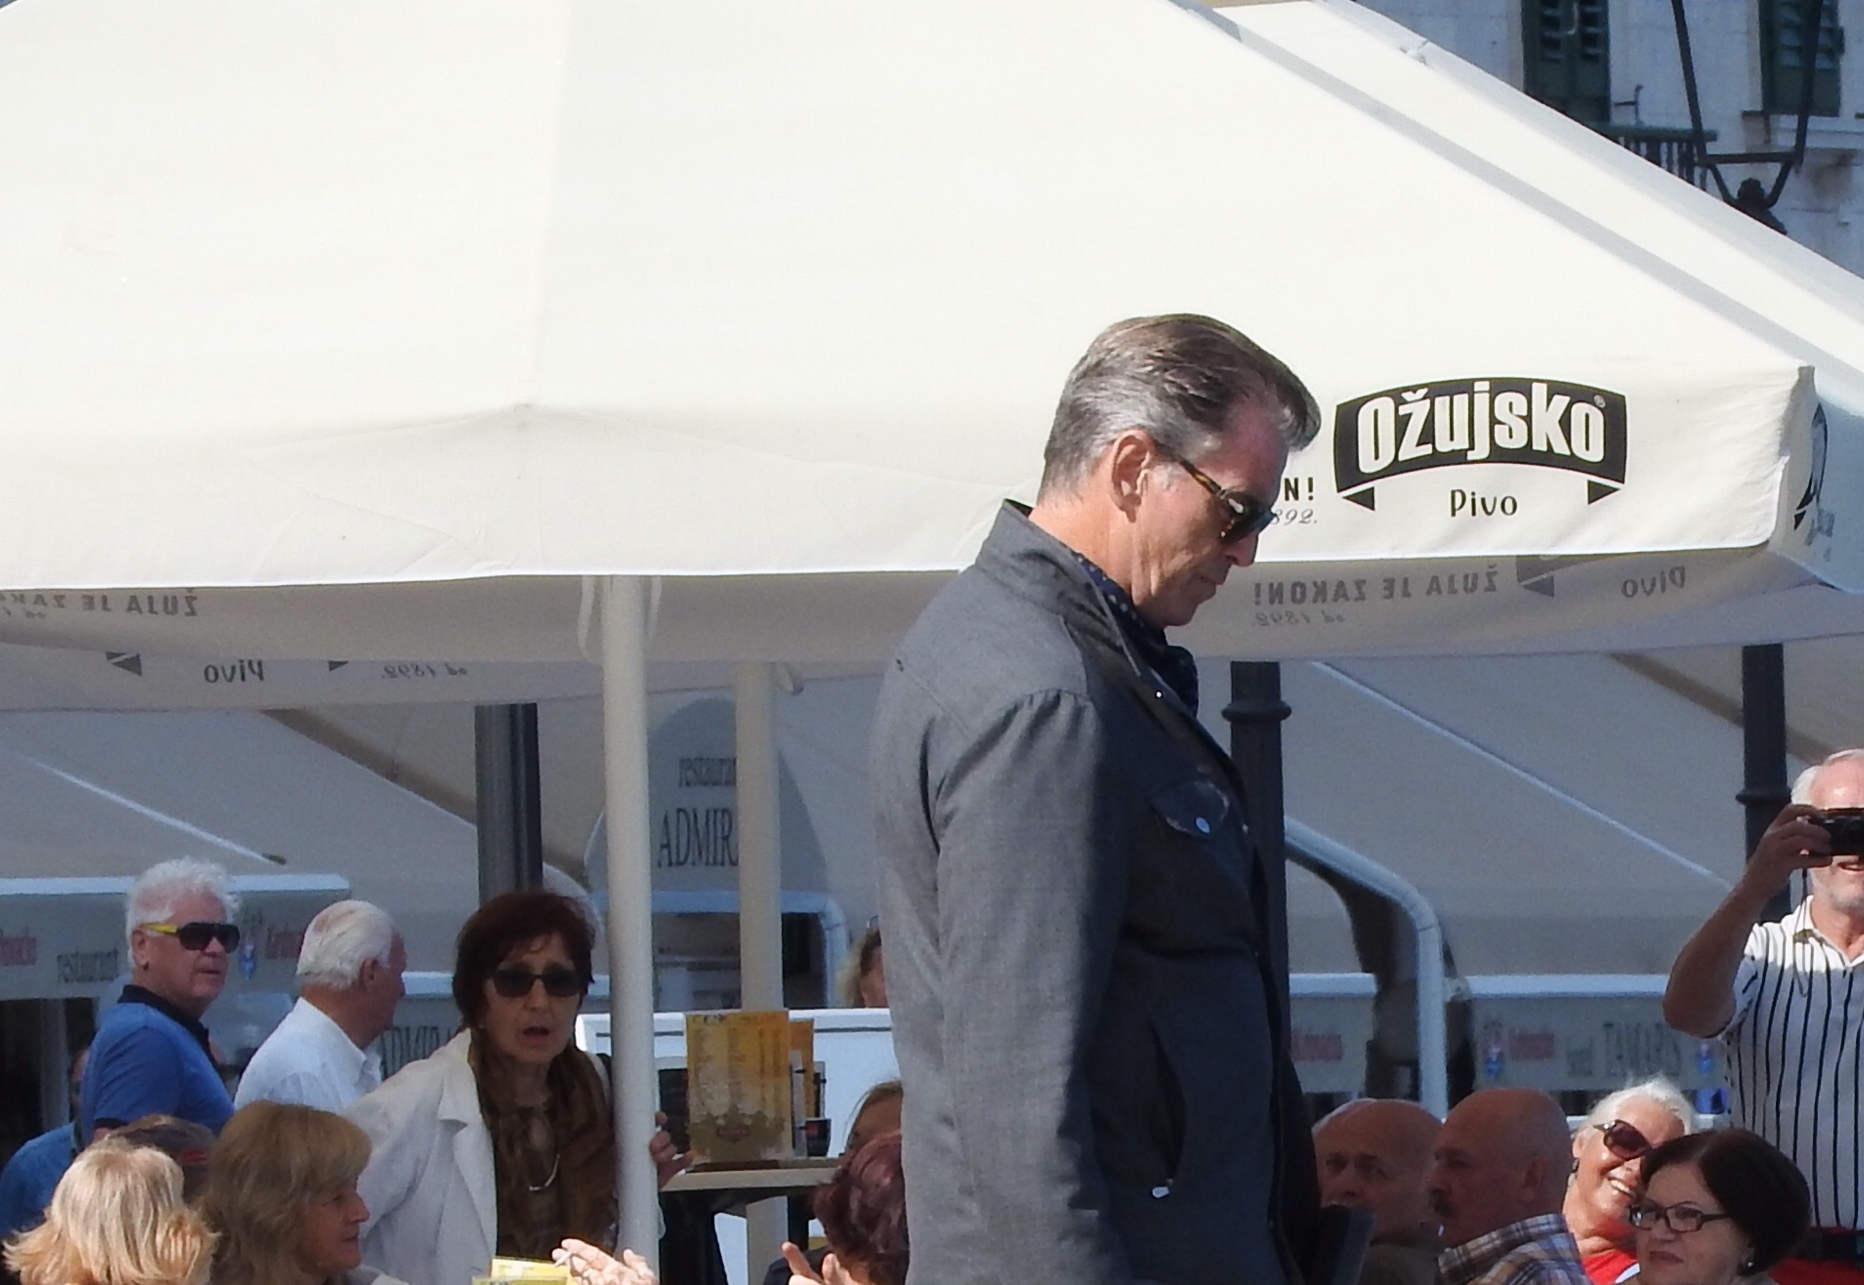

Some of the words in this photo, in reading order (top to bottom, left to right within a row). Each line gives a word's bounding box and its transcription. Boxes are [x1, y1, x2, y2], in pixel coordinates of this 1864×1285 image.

[1356, 380, 1605, 474] Ožujsko
[1450, 488, 1519, 517] Pivo
[657, 807, 740, 869] ADMIR
